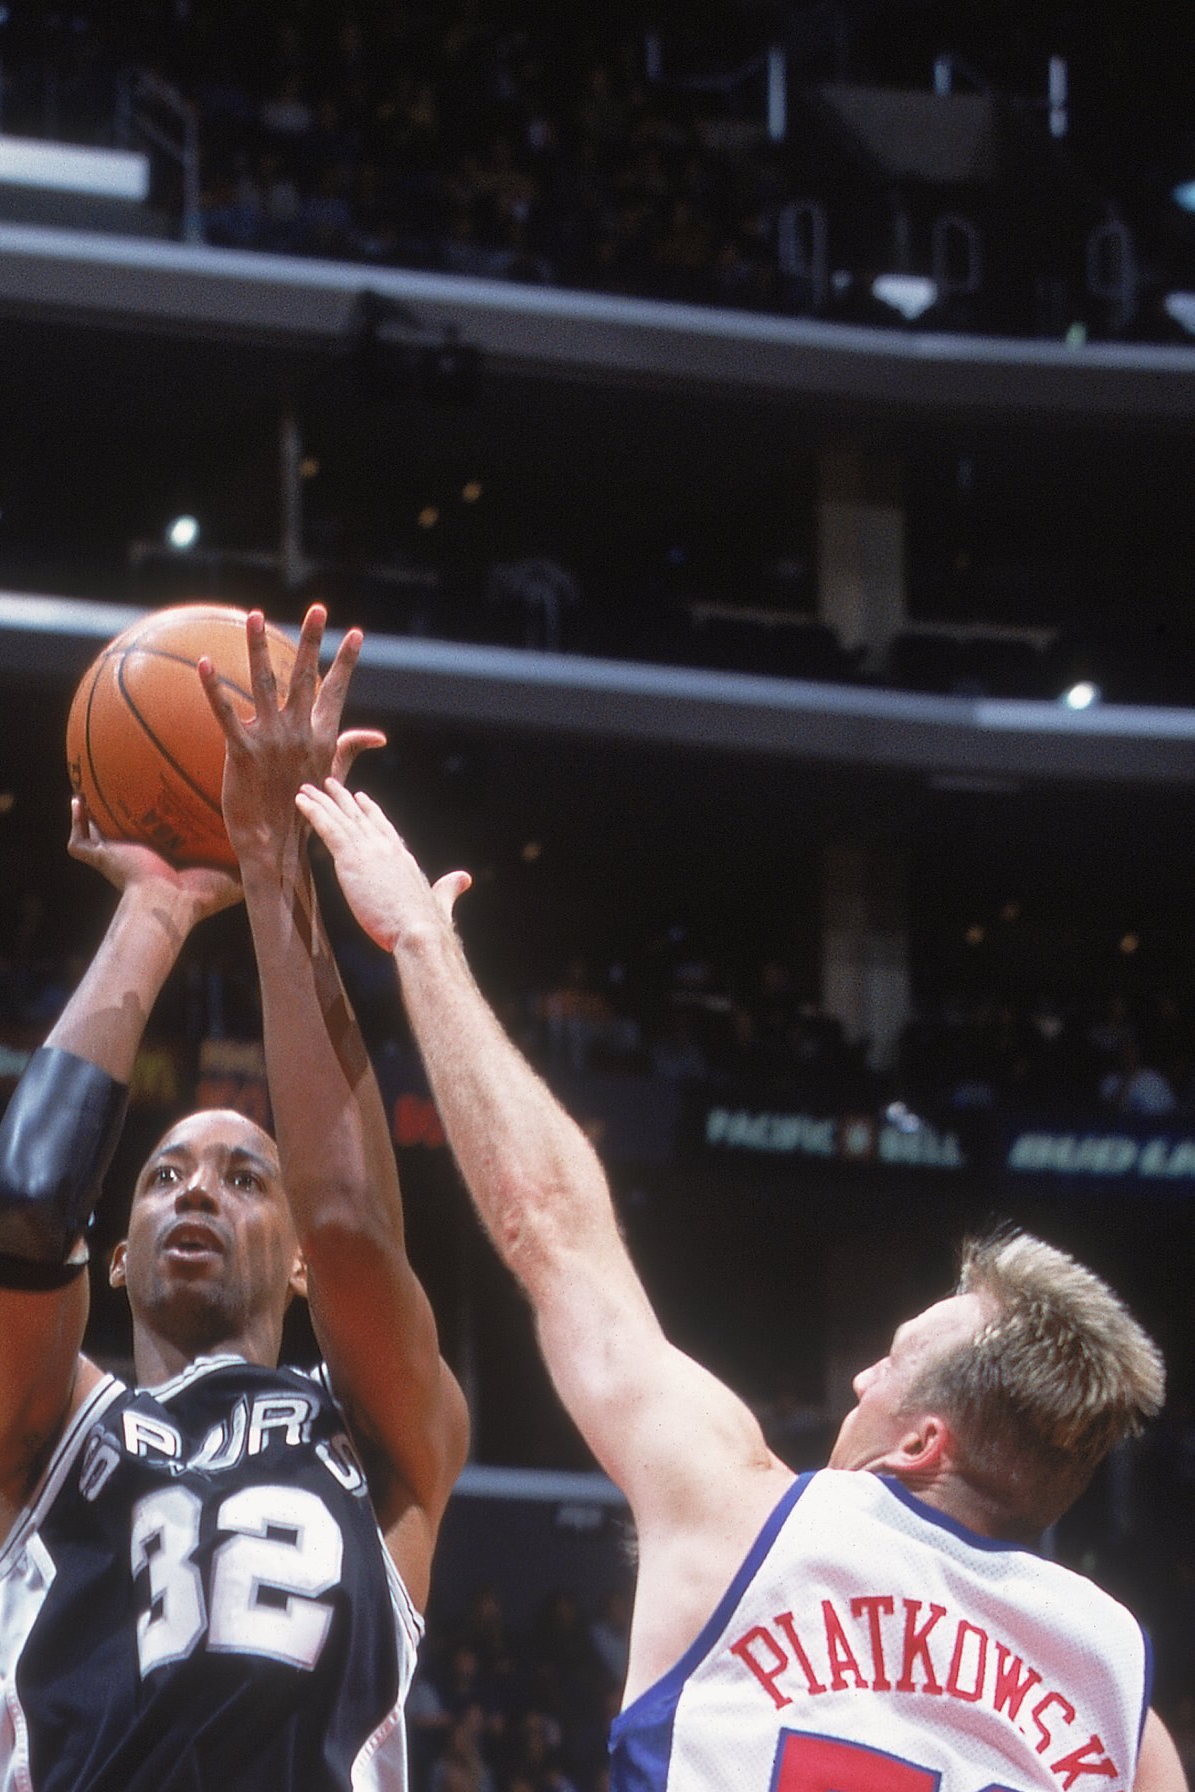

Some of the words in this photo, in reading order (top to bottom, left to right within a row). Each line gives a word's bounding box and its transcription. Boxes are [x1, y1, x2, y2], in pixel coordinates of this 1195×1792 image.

[706, 1108, 836, 1156] PACIFIC
[1009, 1132, 1138, 1174] BUD
[131, 1485, 345, 1682] 32
